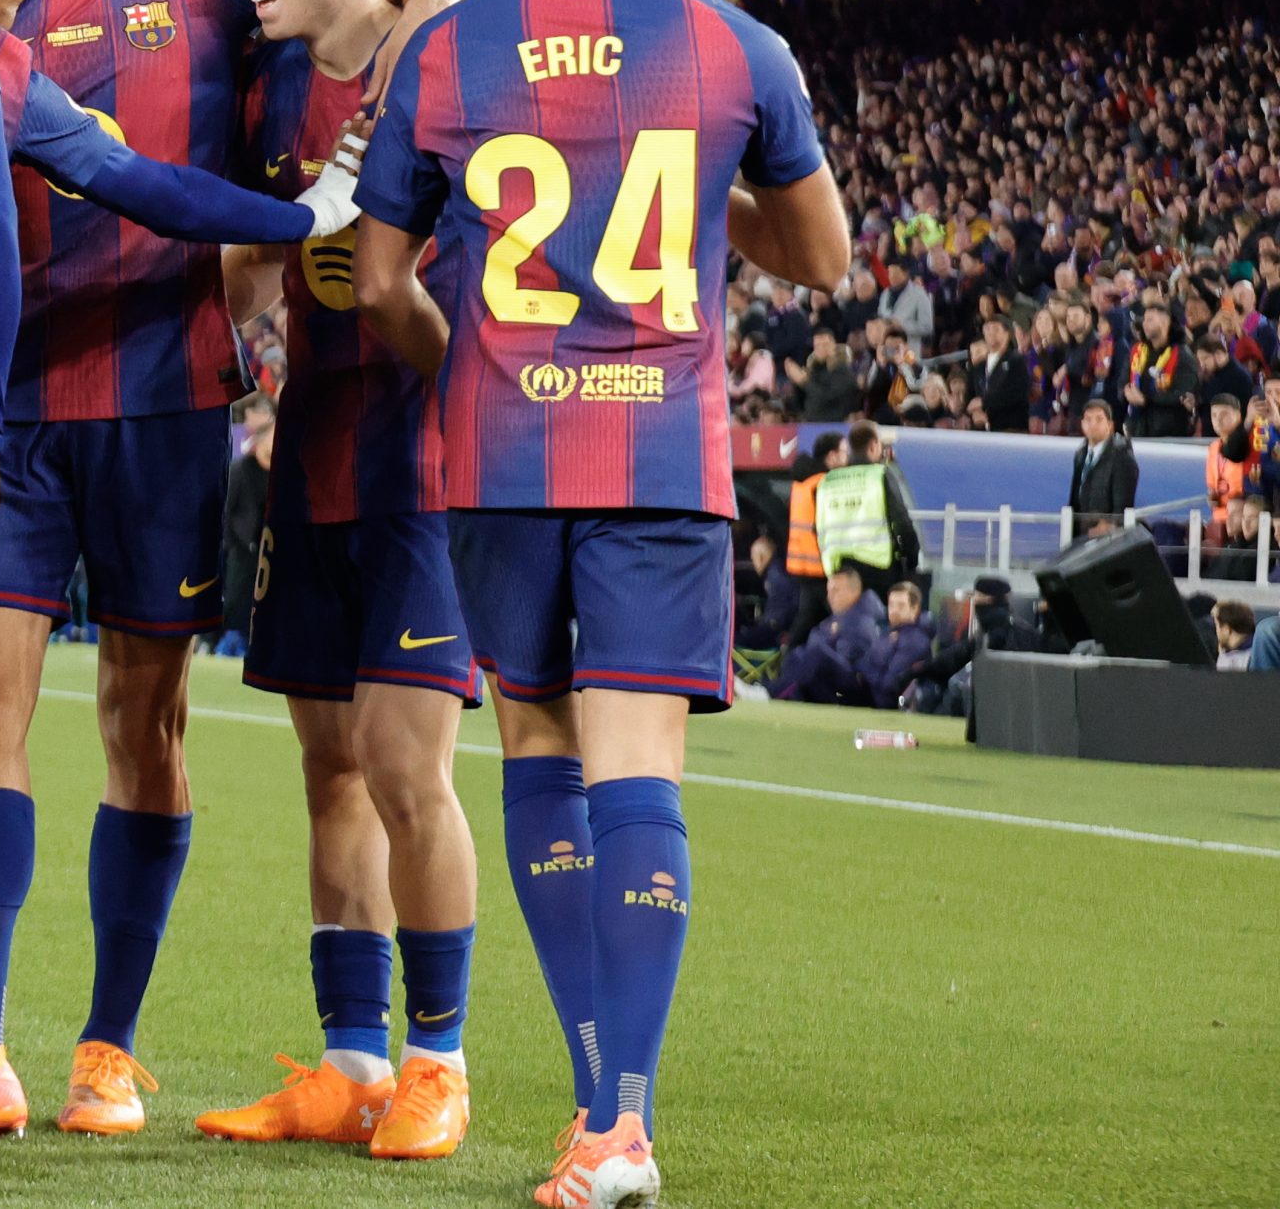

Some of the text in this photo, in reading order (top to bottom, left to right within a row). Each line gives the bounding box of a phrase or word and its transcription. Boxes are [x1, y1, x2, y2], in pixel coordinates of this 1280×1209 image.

[517, 35, 623, 83] ERIC
[465, 129, 699, 332] 24
[580, 379, 664, 395] ACNUR
[581, 364, 664, 380] UNHCR
